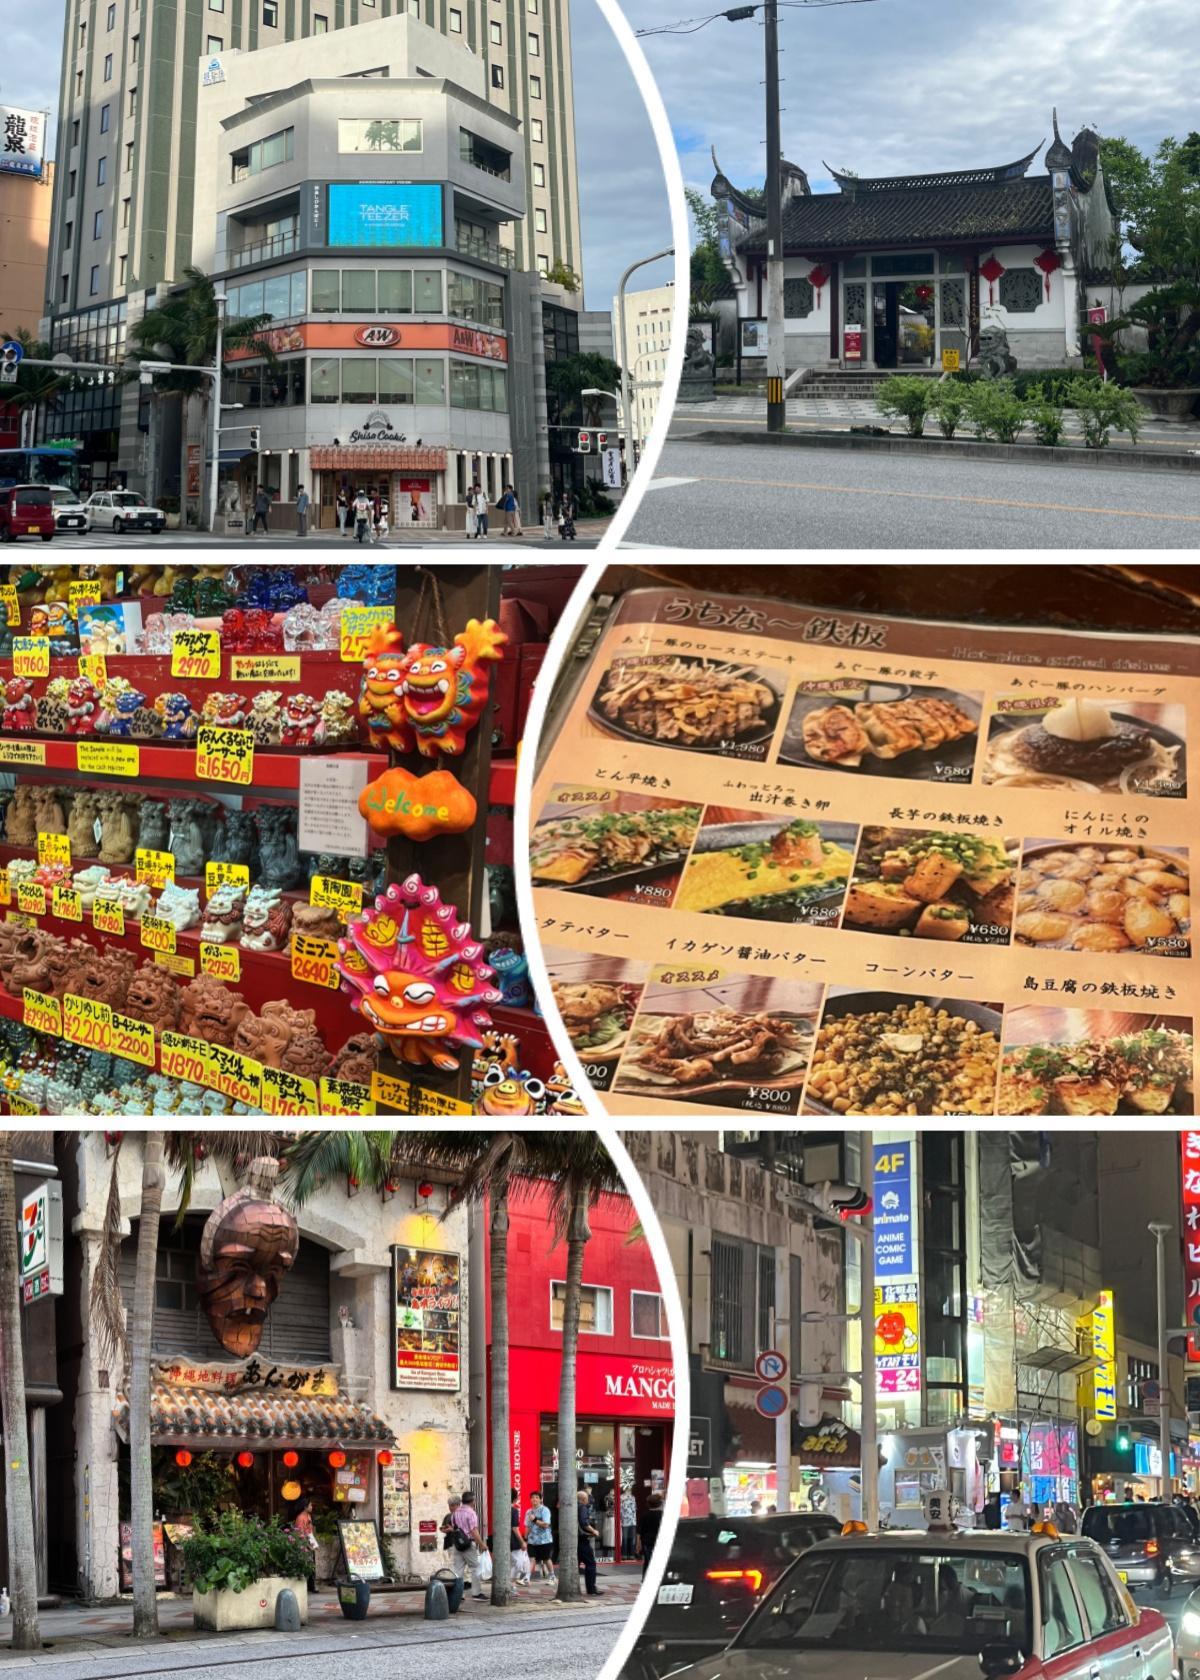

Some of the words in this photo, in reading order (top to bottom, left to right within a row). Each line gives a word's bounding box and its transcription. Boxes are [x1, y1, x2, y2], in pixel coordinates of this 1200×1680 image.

[4, 114, 27, 154] 龍泉
[359, 204, 409, 213] TANGLE
[359, 212, 409, 220] TEEZER
[349, 430, 377, 443] Shisa
[377, 430, 407, 443] Cookie
[175, 631, 212, 646] ガラスペア
[622, 636, 796, 665] あぐー豚のロースステーキ
[1010, 677, 1168, 696] あぐー豚のハンバーグ
[206, 745, 246, 760] シーサー中
[935, 765, 971, 776] ¥580
[595, 768, 672, 789] とん平焼き
[367, 786, 449, 821] Welcome
[749, 792, 831, 811] 出汁巻き卵
[889, 806, 1004, 827] 長芋の鉄板焼き
[1064, 809, 1149, 824] にんにくの
[1063, 824, 1148, 839] オイル焼き
[634, 884, 672, 898] ¥880
[535, 917, 630, 939] タテバター
[969, 923, 1009, 936] ¥680
[295, 935, 336, 959] ミニブー
[1146, 936, 1188, 949] ¥580
[665, 937, 827, 965] イカゲソ醤油バター
[865, 963, 975, 980] コーンバター
[1023, 975, 1177, 1000] 島豆腐の鉄板焼き
[210, 1047, 243, 1070] スマイル
[748, 1087, 791, 1102] ¥800
[874, 1152, 904, 1173] 4F
[877, 1233, 904, 1243] ANIME
[875, 1244, 906, 1254] COMIC
[878, 1255, 904, 1265] GAME
